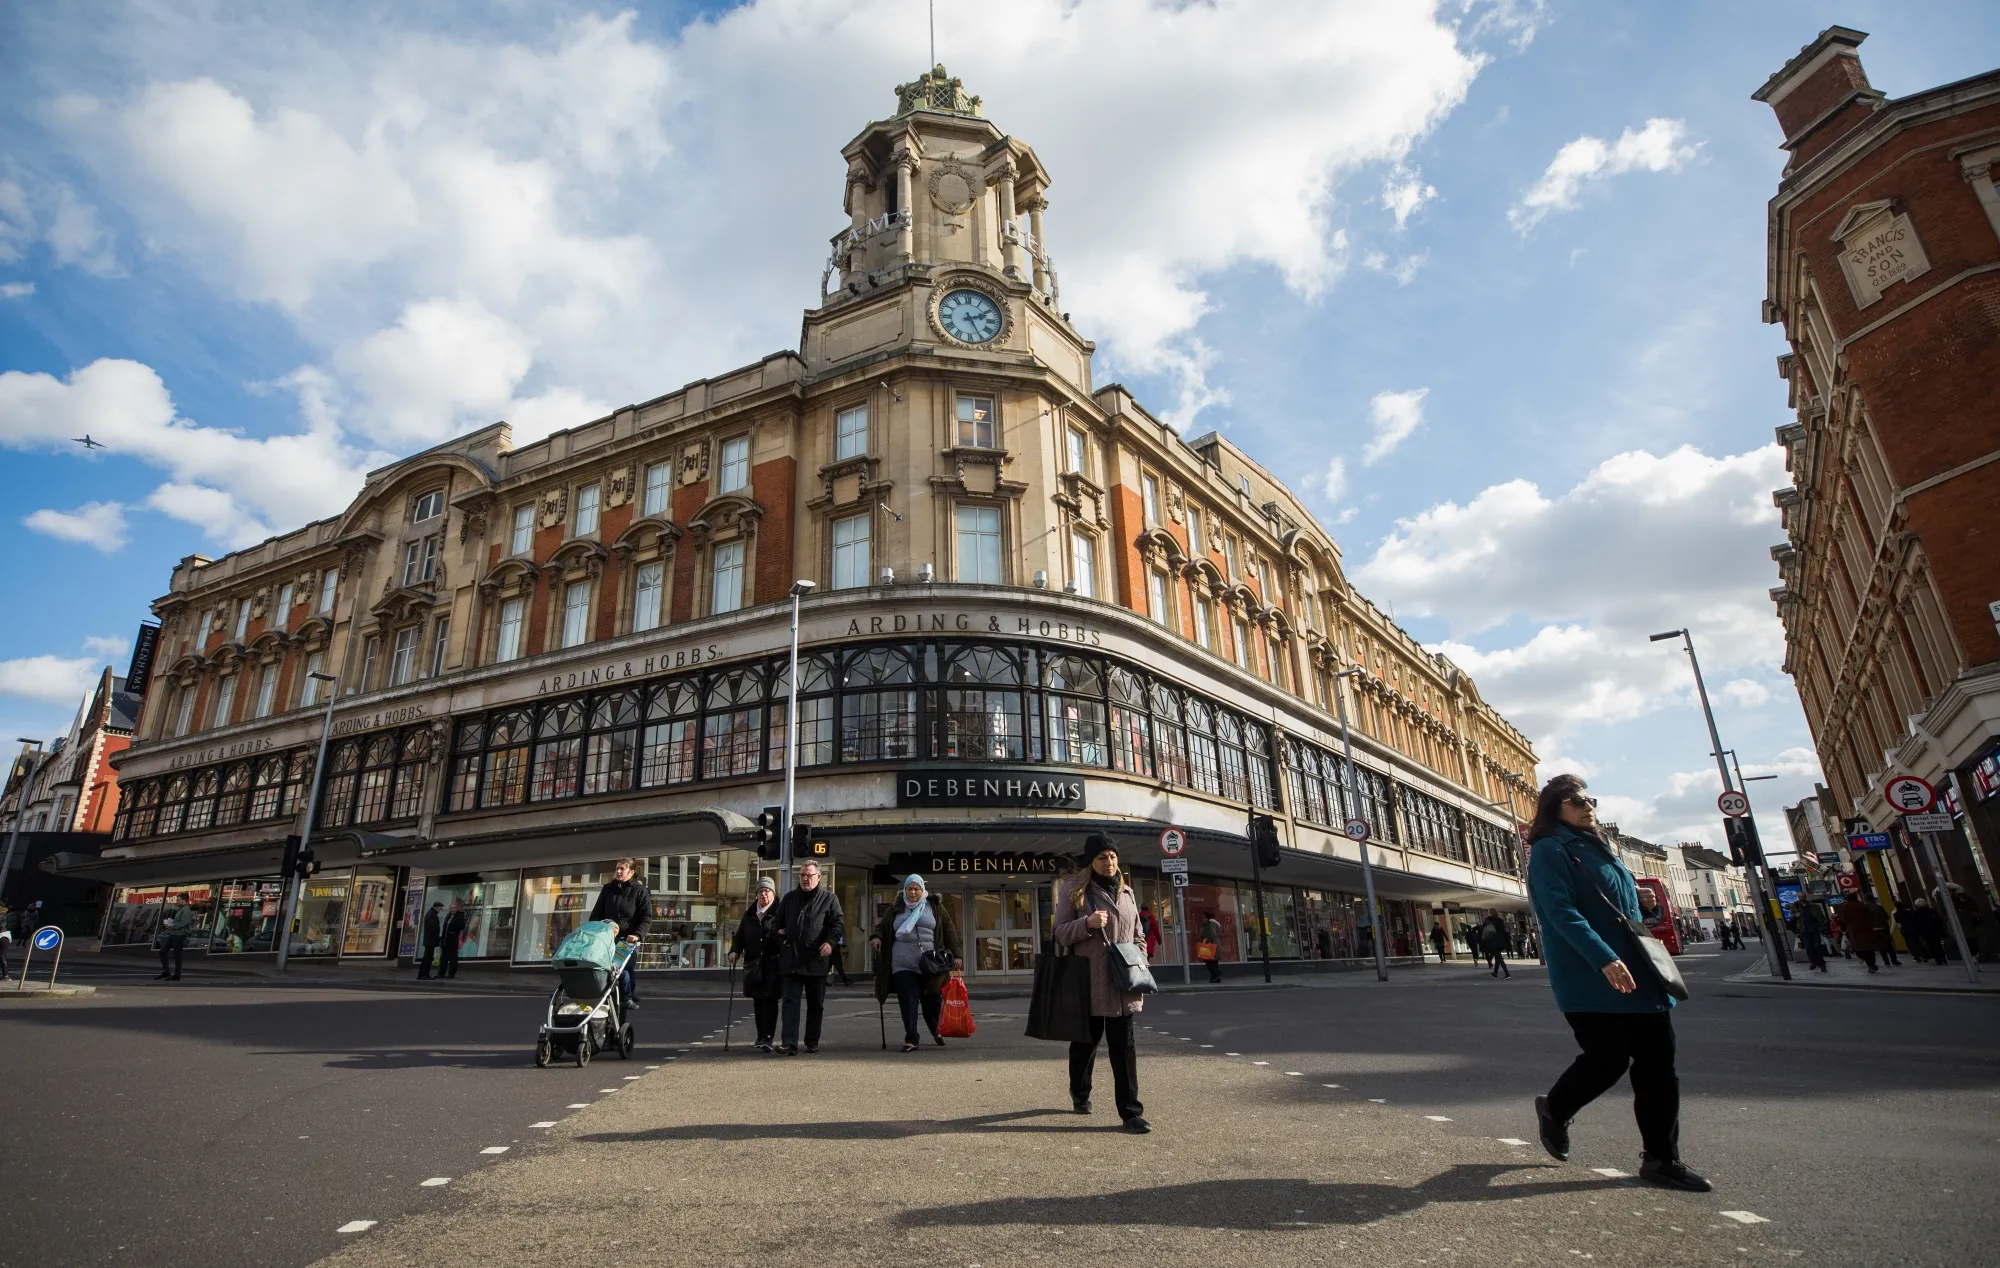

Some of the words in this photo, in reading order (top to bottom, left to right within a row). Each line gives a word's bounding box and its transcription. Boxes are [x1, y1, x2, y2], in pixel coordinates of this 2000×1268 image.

[1852, 229, 1905, 264] FRANCIS
[1870, 245, 1893, 264] AND
[1868, 249, 1904, 277] SON
[847, 613, 969, 635] ARDING
[988, 615, 1000, 632] &
[1018, 617, 1101, 646] HOBBS
[132, 629, 153, 690] DEBENHAMS
[538, 665, 615, 693] ARDING
[623, 662, 633, 677] &
[644, 644, 717, 674] HOBBS
[332, 715, 372, 736] ARDING
[373, 714, 381, 727] &
[384, 705, 424, 724] HOBBS
[169, 749, 214, 769] ARDING
[218, 746, 226, 759] &
[230, 737, 271, 757] HOBBS
[906, 779, 1081, 800] DEBENHAMS
[1723, 798, 1745, 810] 20
[1347, 825, 1364, 835] 20
[1852, 836, 1885, 848] METRO
[814, 843, 826, 854] 06
[932, 858, 1056, 871] DEBENHAMS
